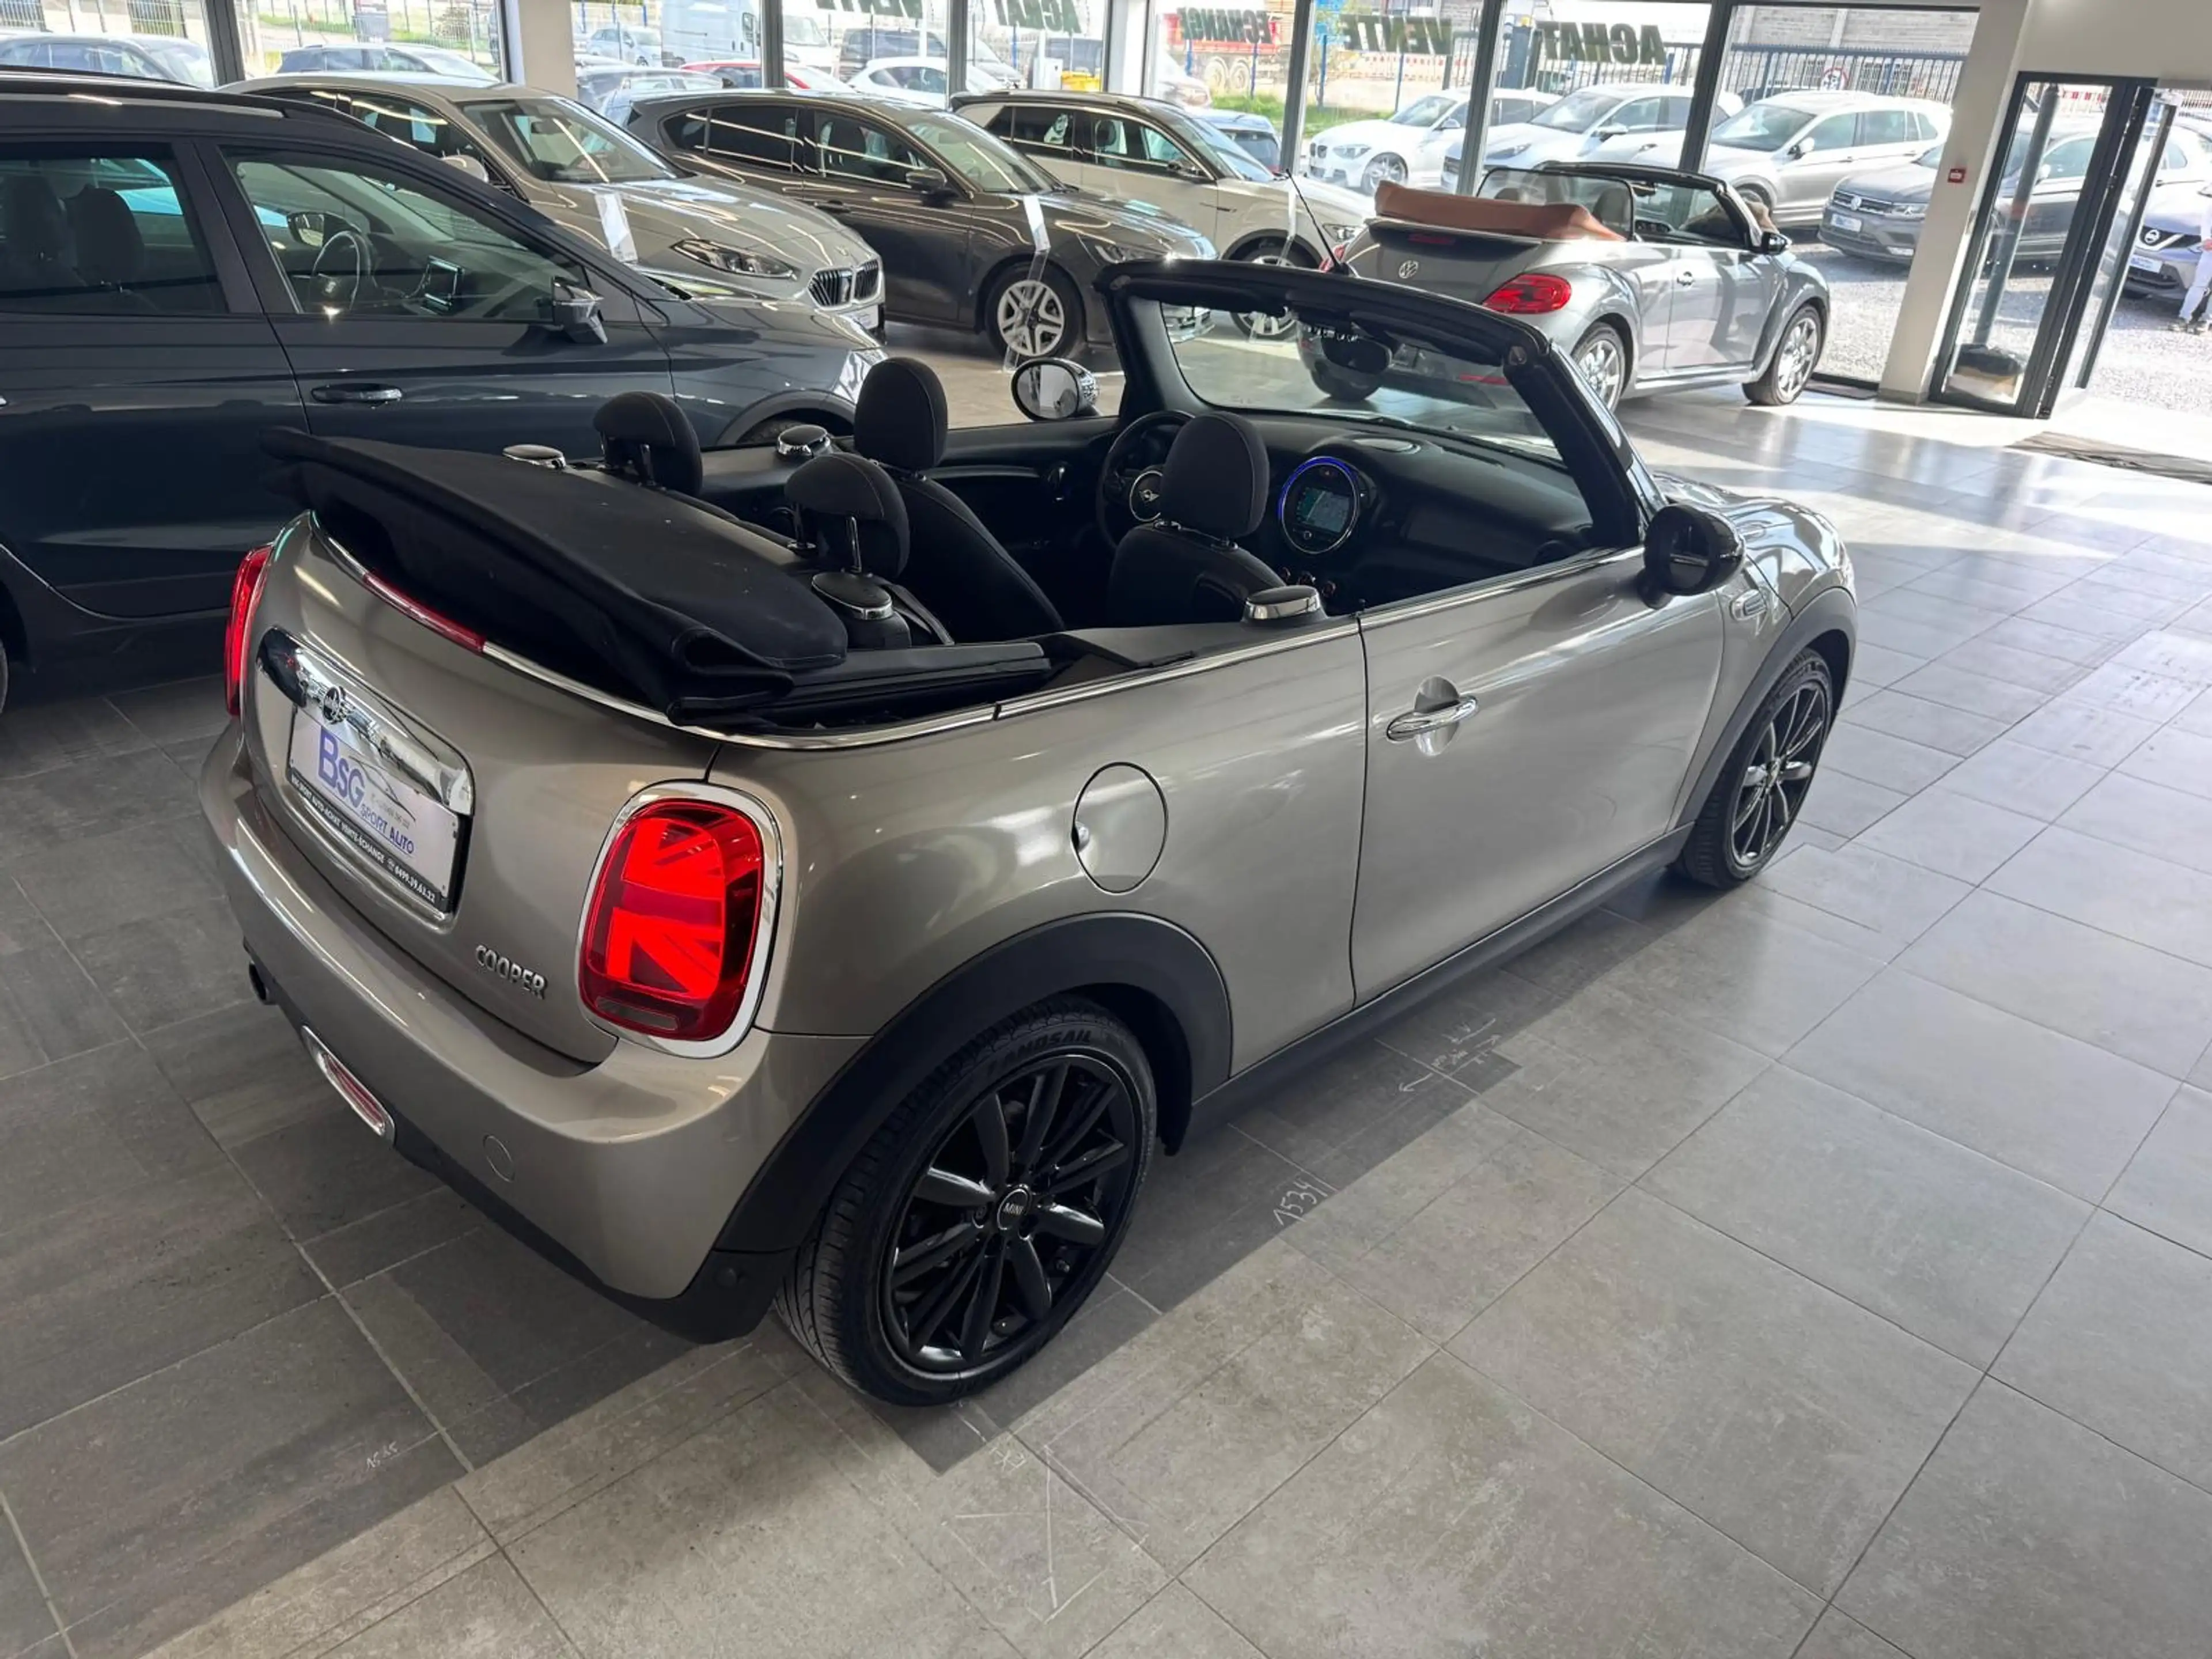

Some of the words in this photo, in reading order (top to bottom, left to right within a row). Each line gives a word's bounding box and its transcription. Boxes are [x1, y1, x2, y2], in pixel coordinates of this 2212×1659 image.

[389, 826, 414, 854] AUTO
[476, 944, 546, 1000] COOPER
[1003, 1202, 1024, 1215] MINI
